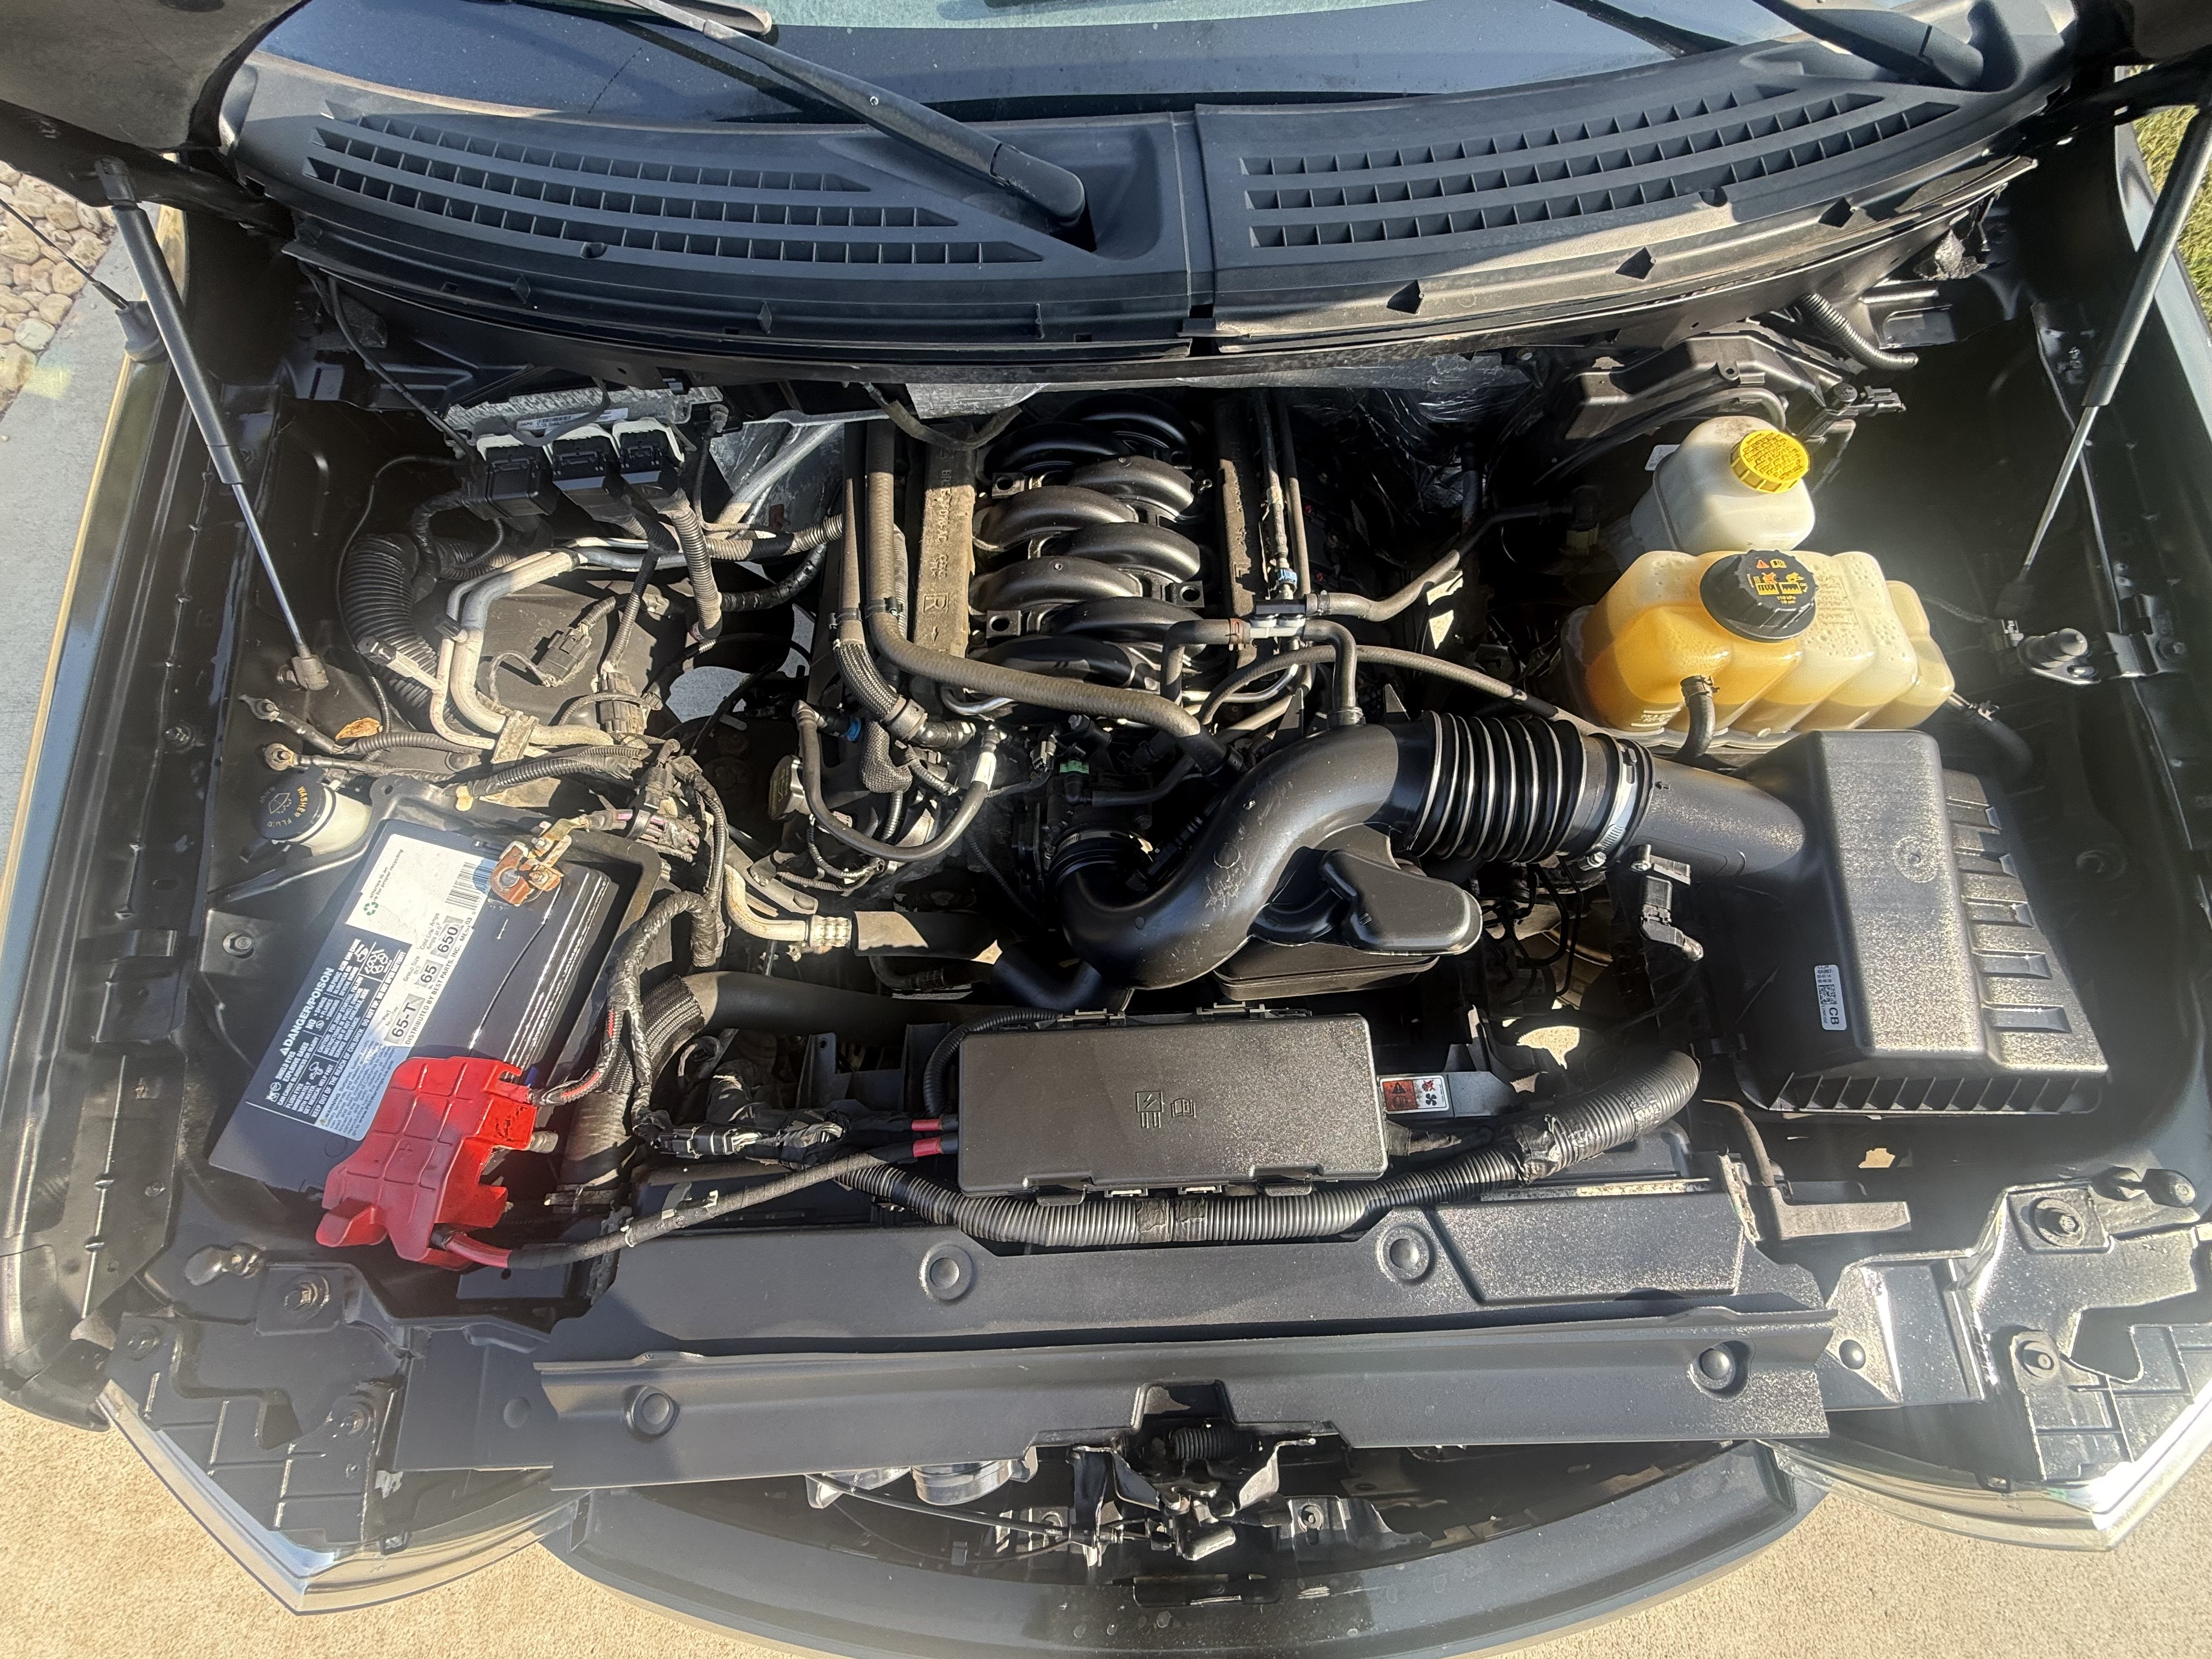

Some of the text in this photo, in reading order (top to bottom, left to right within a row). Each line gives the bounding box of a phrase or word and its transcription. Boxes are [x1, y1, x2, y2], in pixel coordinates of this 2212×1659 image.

[294, 786, 308, 817] WASHER
[267, 818, 293, 828] FLUID
[381, 872, 392, 887] proper
[390, 850, 403, 870] recycling
[430, 913, 440, 926] Amps
[420, 939, 428, 949] Cold
[427, 937, 437, 950] Amps
[438, 927, 458, 952] 650
[404, 956, 420, 981] Group Size
[420, 966, 437, 983] 65
[285, 967, 334, 1048] DANGER/POISON
[315, 997, 328, 1013] SPARKS
[321, 999, 333, 1015] FLAMES
[382, 1010, 391, 1020] Part
[405, 1006, 430, 1045] DISTRIBUTED
[432, 980, 443, 994] BEST
[1829, 1007, 1839, 1025] CB
[306, 1019, 317, 1029] NO
[329, 1024, 337, 1032] FOR
[392, 1002, 416, 1037] 65-T
[275, 1051, 295, 1080] SHIELD EYES
[283, 1042, 309, 1082] EXPLOSIVE GASES
[312, 1105, 322, 1118] KEEP
[319, 1094, 328, 1104] OUT
[329, 1076, 338, 1086] THE
[335, 1060, 347, 1075] REACH
[366, 1009, 375, 1018] NOT
[278, 1096, 286, 1105] CAN
[283, 1082, 294, 1096] CAUSE
[291, 1059, 307, 1082] BLINDNESS
[308, 1087, 321, 1105] MEDICAL
[319, 1076, 328, 1086] HELP
[325, 1065, 334, 1075] FAST
[286, 1083, 303, 1109] FLUSH EYES
[297, 1101, 308, 1113] WITH
